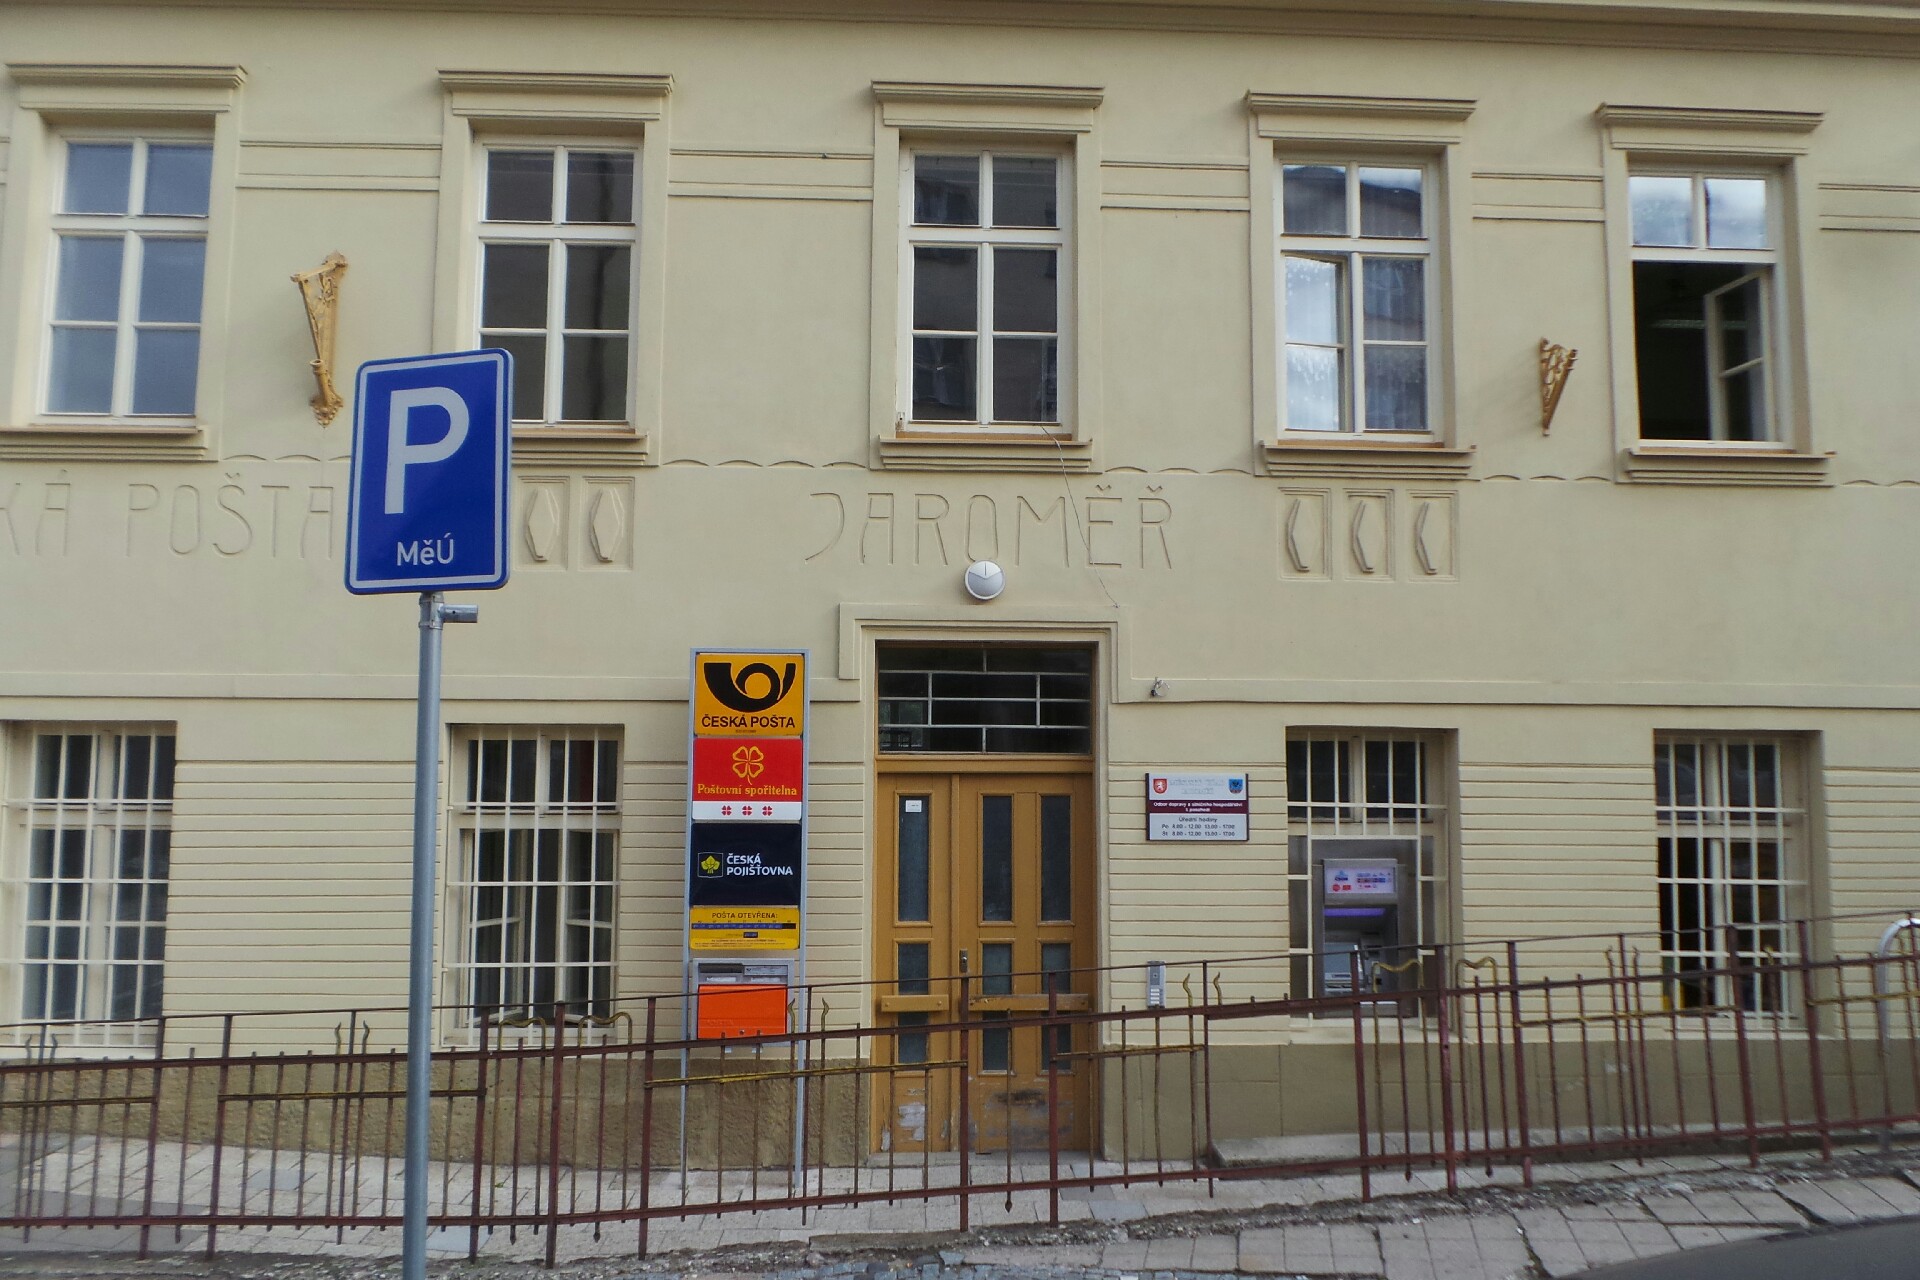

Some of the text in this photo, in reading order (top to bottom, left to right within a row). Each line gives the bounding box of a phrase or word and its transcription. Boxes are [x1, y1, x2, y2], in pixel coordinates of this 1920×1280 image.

[384, 386, 470, 515] P
[126, 472, 335, 559] POŠTA
[804, 484, 1173, 569] JAROMĚŘ
[396, 532, 455, 567] MěÚ
[701, 713, 796, 728] ČESKÁ POŠTA
[697, 783, 798, 797] Poštovní spořitelna
[726, 852, 762, 865] ČESKÁ
[726, 864, 794, 877] POJIŠŤOVNA
[711, 910, 778, 919] POŠTA OTEVŘENA:
